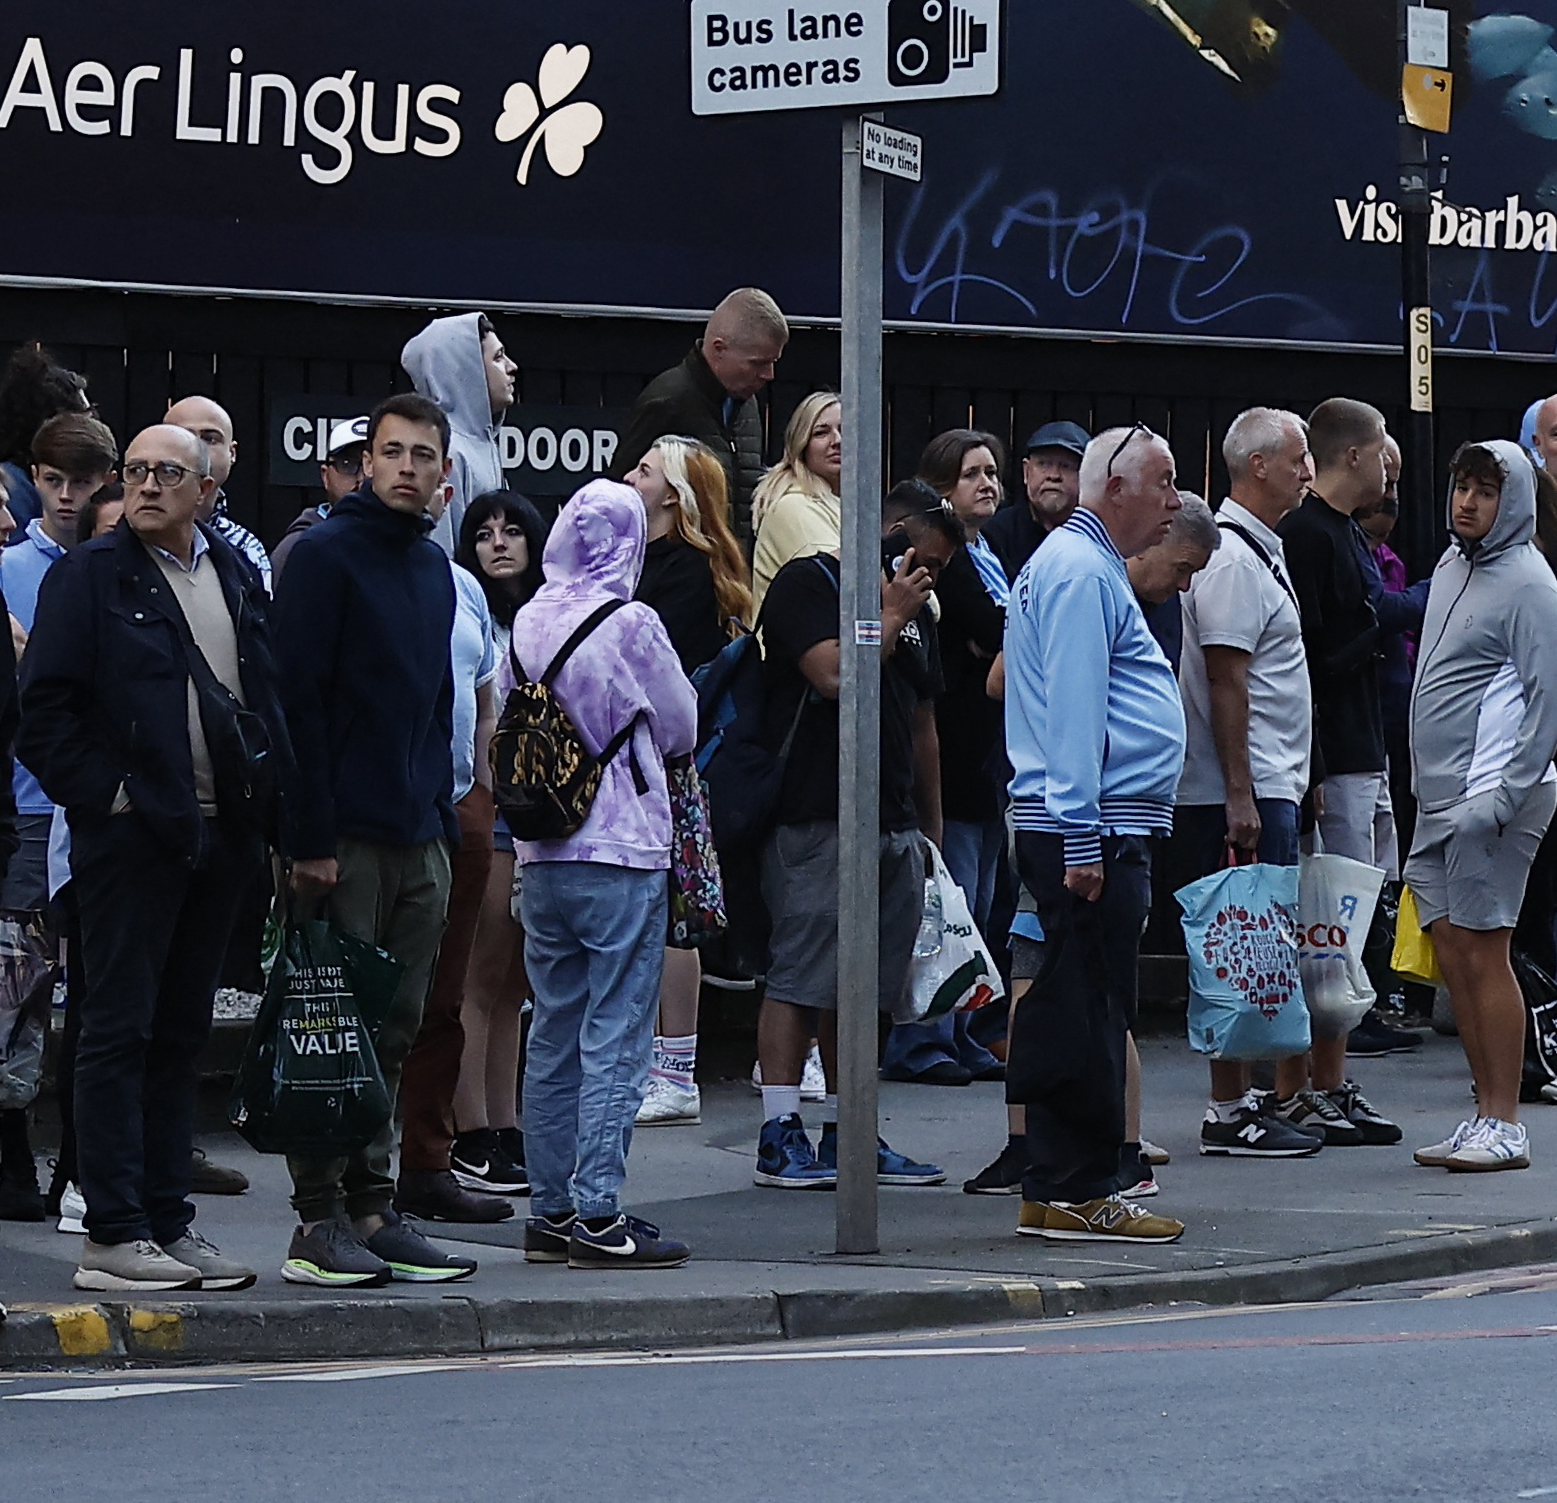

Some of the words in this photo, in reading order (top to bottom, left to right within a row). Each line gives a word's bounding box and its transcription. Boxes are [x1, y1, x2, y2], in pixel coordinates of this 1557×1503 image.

[706, 14, 773, 48] Bus
[787, 8, 864, 42] lane
[707, 56, 861, 93] cameras
[175, 47, 462, 185] Lingus
[866, 147, 876, 161] at
[878, 152, 895, 169] any
[898, 155, 918, 173] time
[867, 127, 881, 144] No
[884, 132, 918, 157] loading
